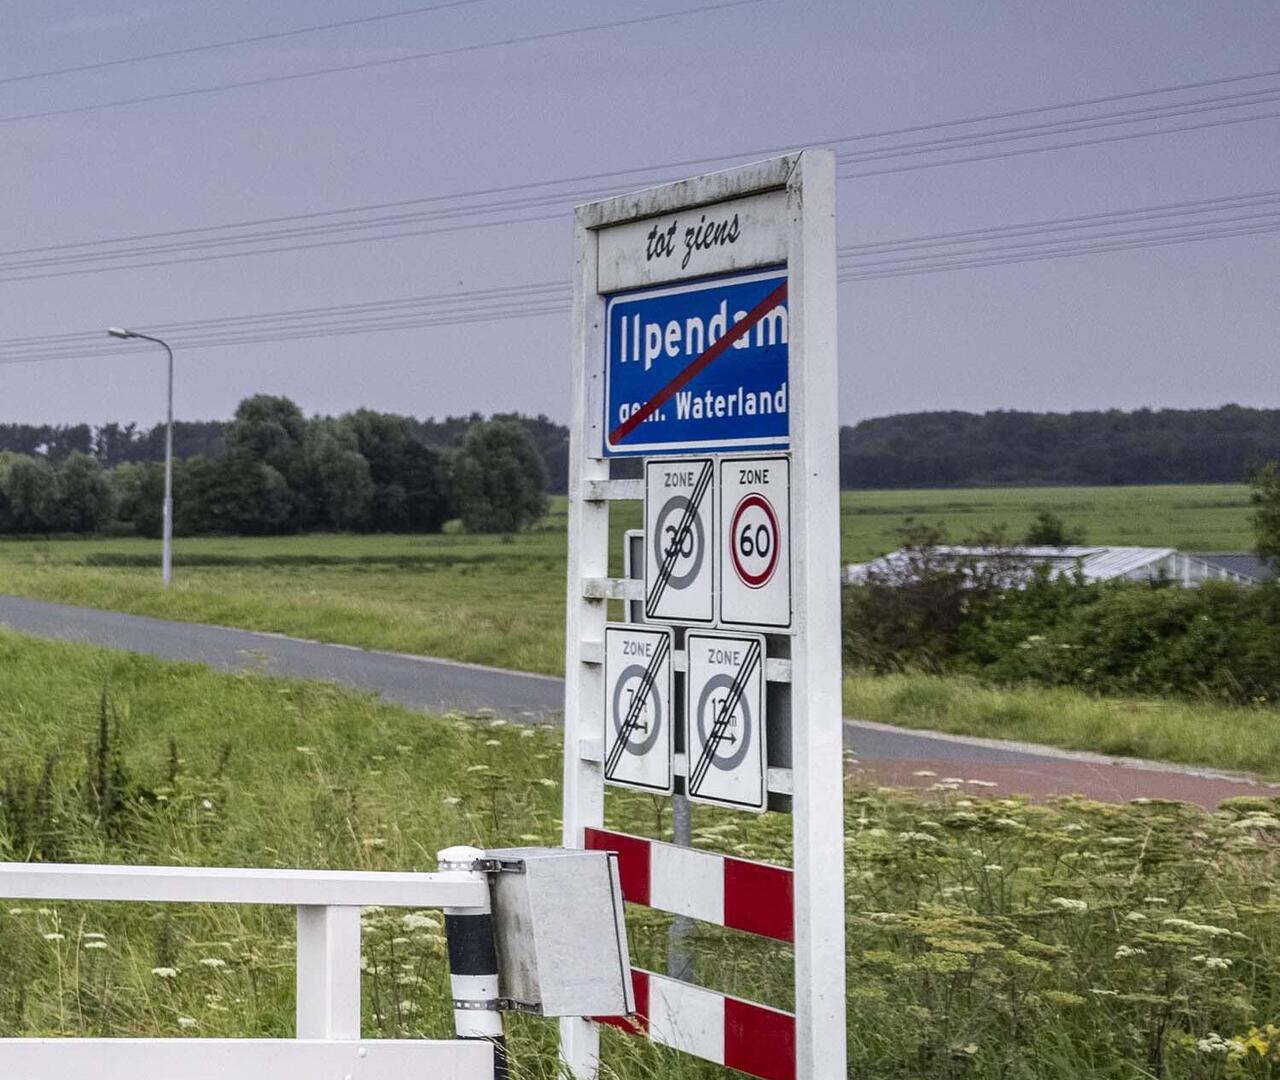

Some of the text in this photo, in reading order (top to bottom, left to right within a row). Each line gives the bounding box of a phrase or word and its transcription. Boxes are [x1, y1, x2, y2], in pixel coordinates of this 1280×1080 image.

[647, 213, 740, 270] tot ziens
[620, 299, 788, 371] Ilpendam
[676, 382, 787, 421] Waterland
[664, 472, 694, 488] ZONE
[739, 469, 770, 485] ZONE
[664, 525, 694, 558] 30
[740, 524, 770, 558] 60
[623, 641, 652, 657] ZONE
[708, 649, 740, 666] ZONE
